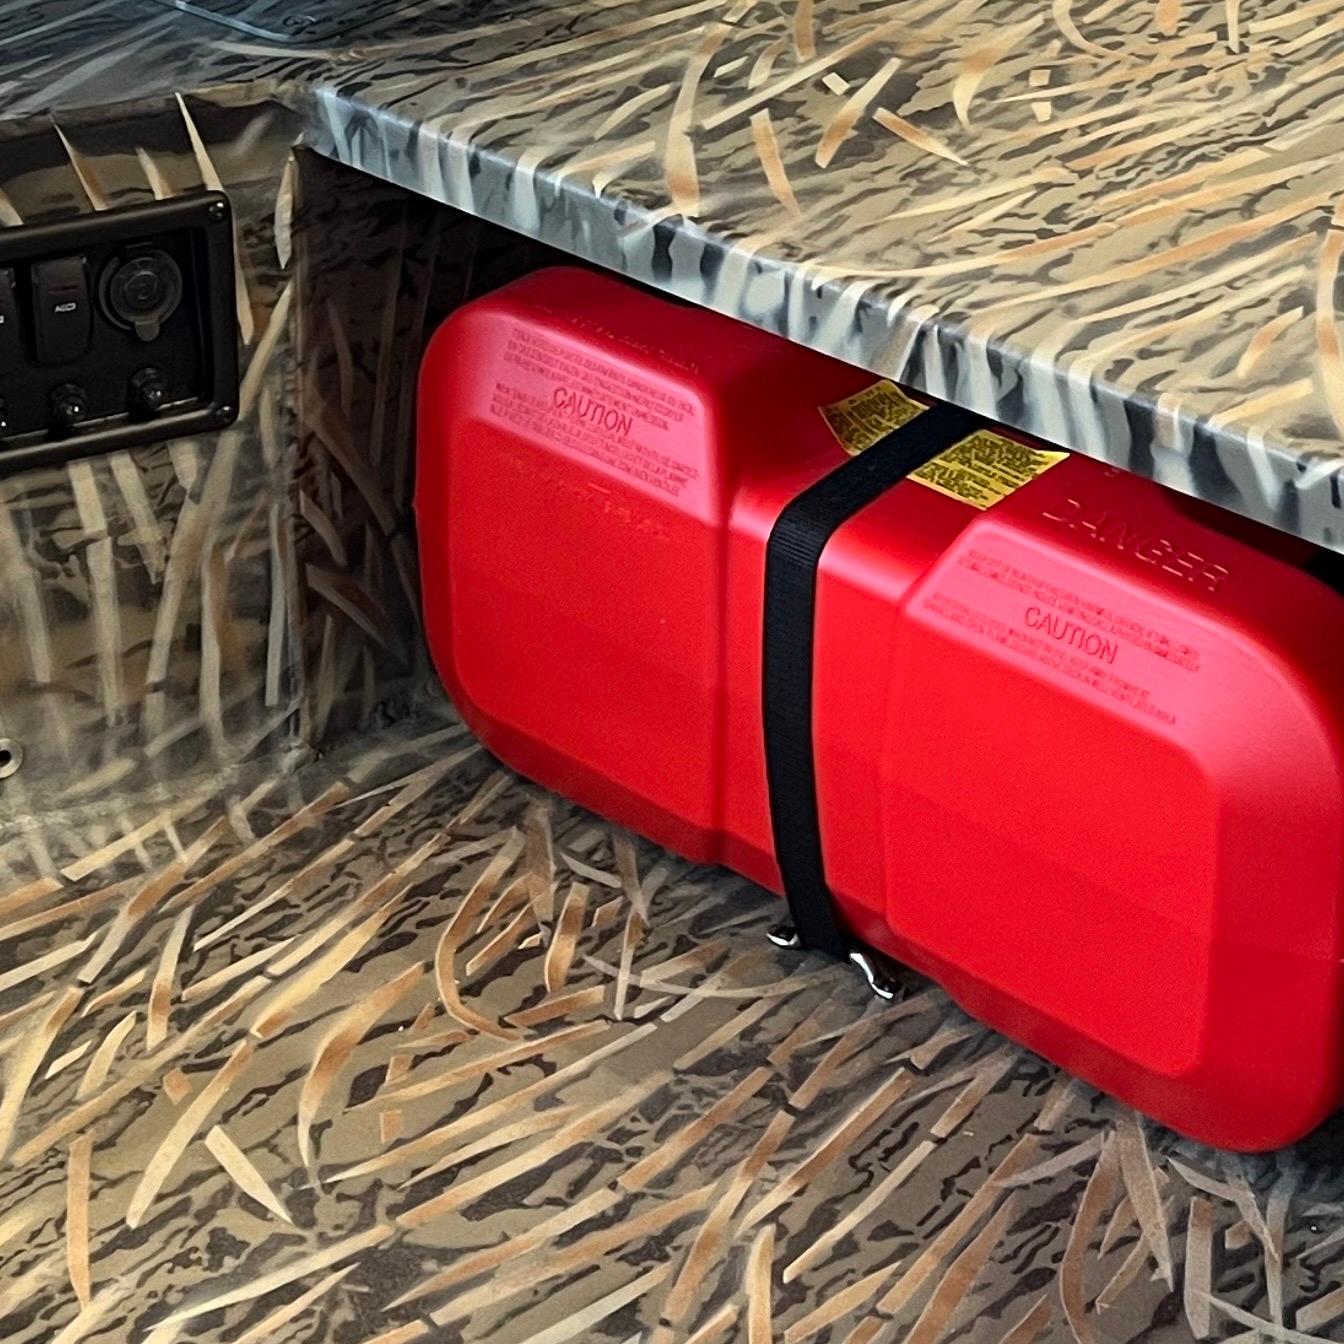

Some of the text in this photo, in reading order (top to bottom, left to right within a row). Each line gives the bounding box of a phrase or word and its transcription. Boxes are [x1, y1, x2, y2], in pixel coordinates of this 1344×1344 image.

[552, 386, 633, 437] CAUTION
[1042, 498, 1229, 592] DANGER
[1024, 606, 1119, 665] CAUTION
